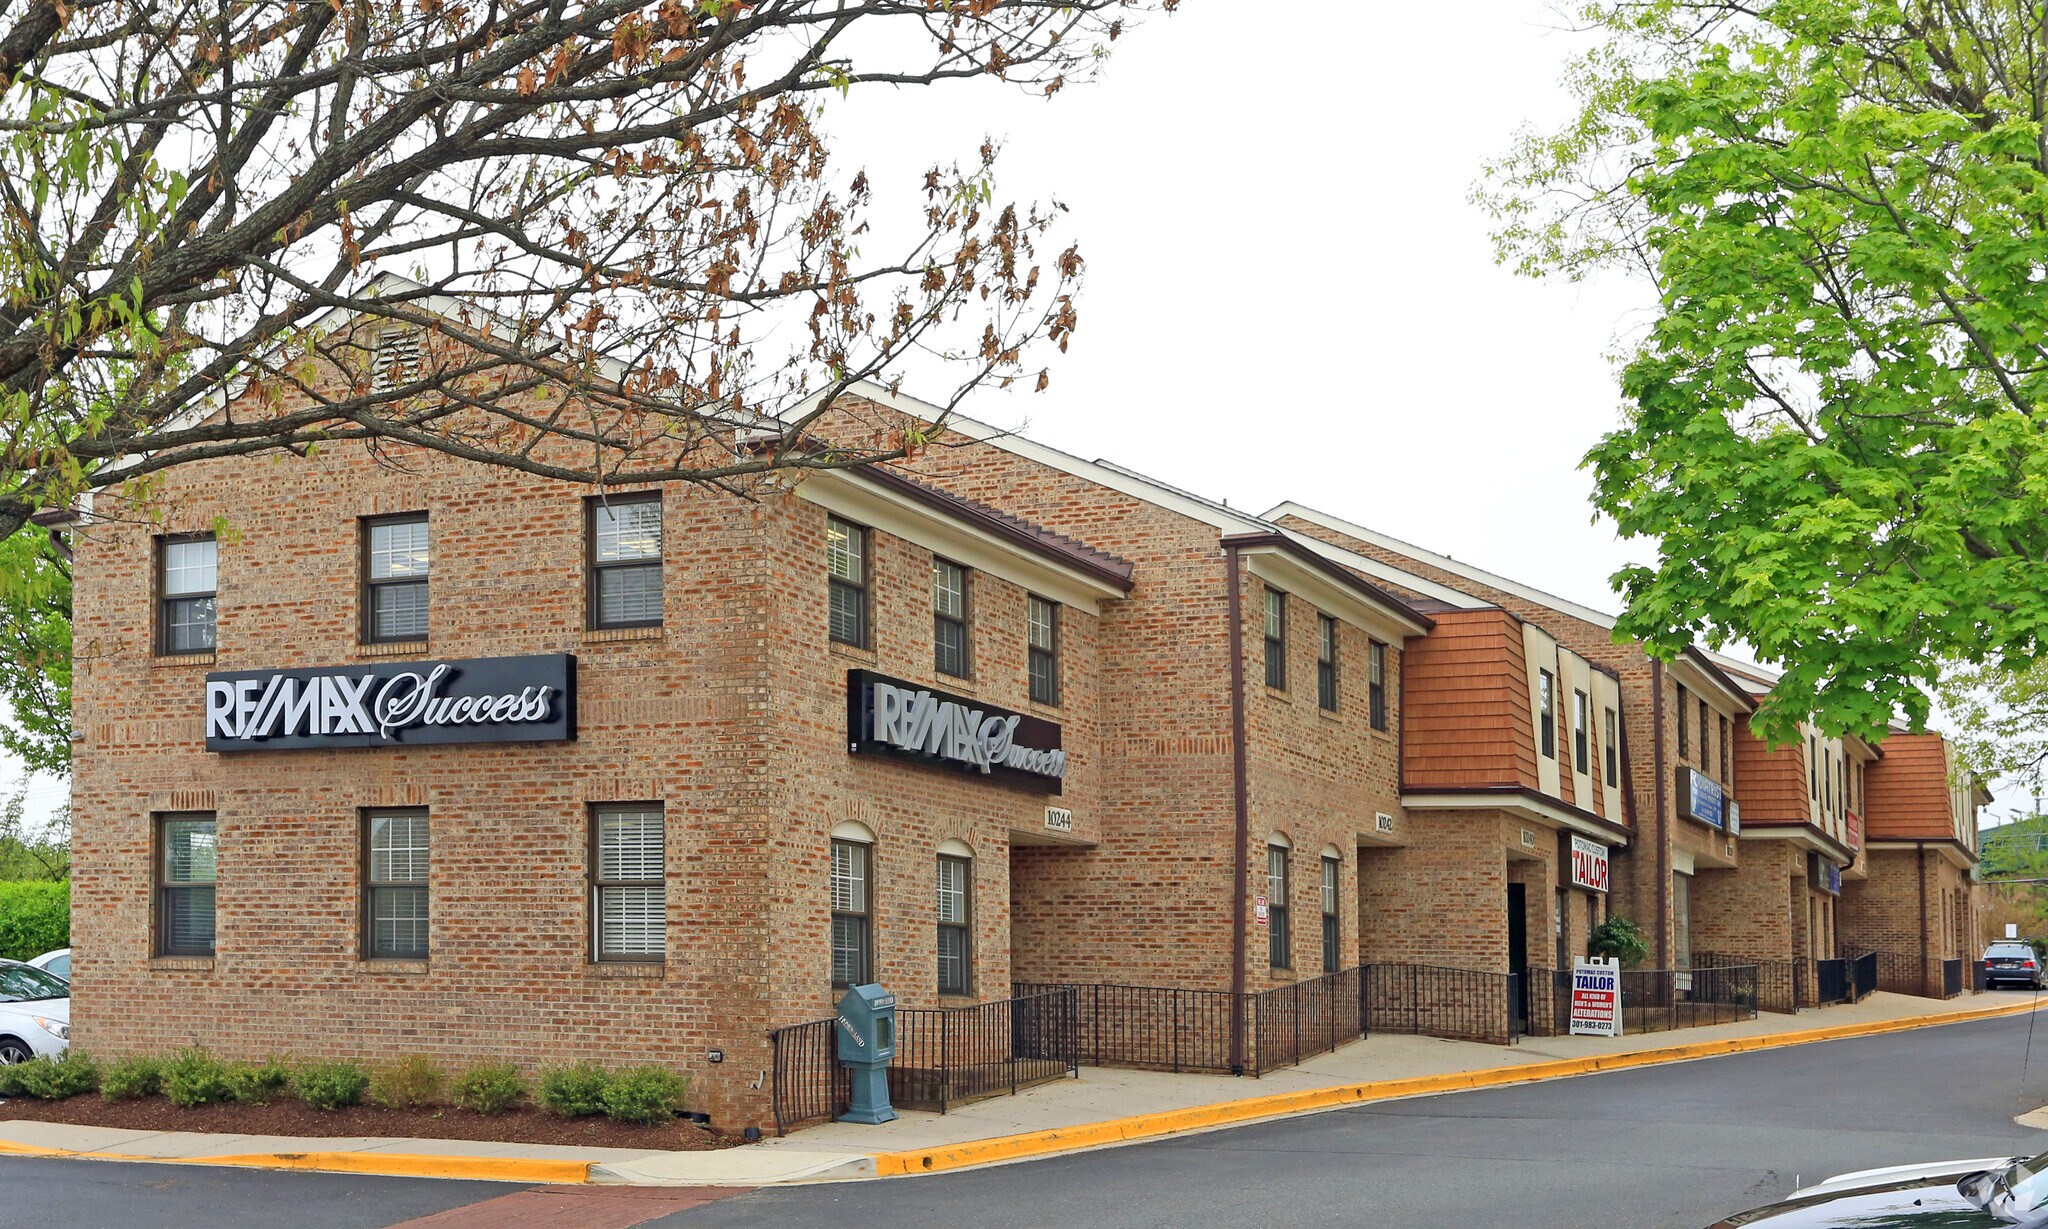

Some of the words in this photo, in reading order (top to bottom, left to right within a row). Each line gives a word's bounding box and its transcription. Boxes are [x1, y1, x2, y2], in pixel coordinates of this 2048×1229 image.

[207, 674, 376, 740] RE/MAX
[374, 663, 553, 740] Success
[874, 683, 984, 764] RE/MAX
[979, 715, 1067, 778] Success
[1047, 809, 1071, 829] 10244
[1572, 850, 1607, 890] TAILOR
[1575, 975, 1614, 990] TAILOR
[1573, 1008, 1613, 1019] ALTERATIONS
[1572, 1020, 1612, 1030] 301-983-0273
